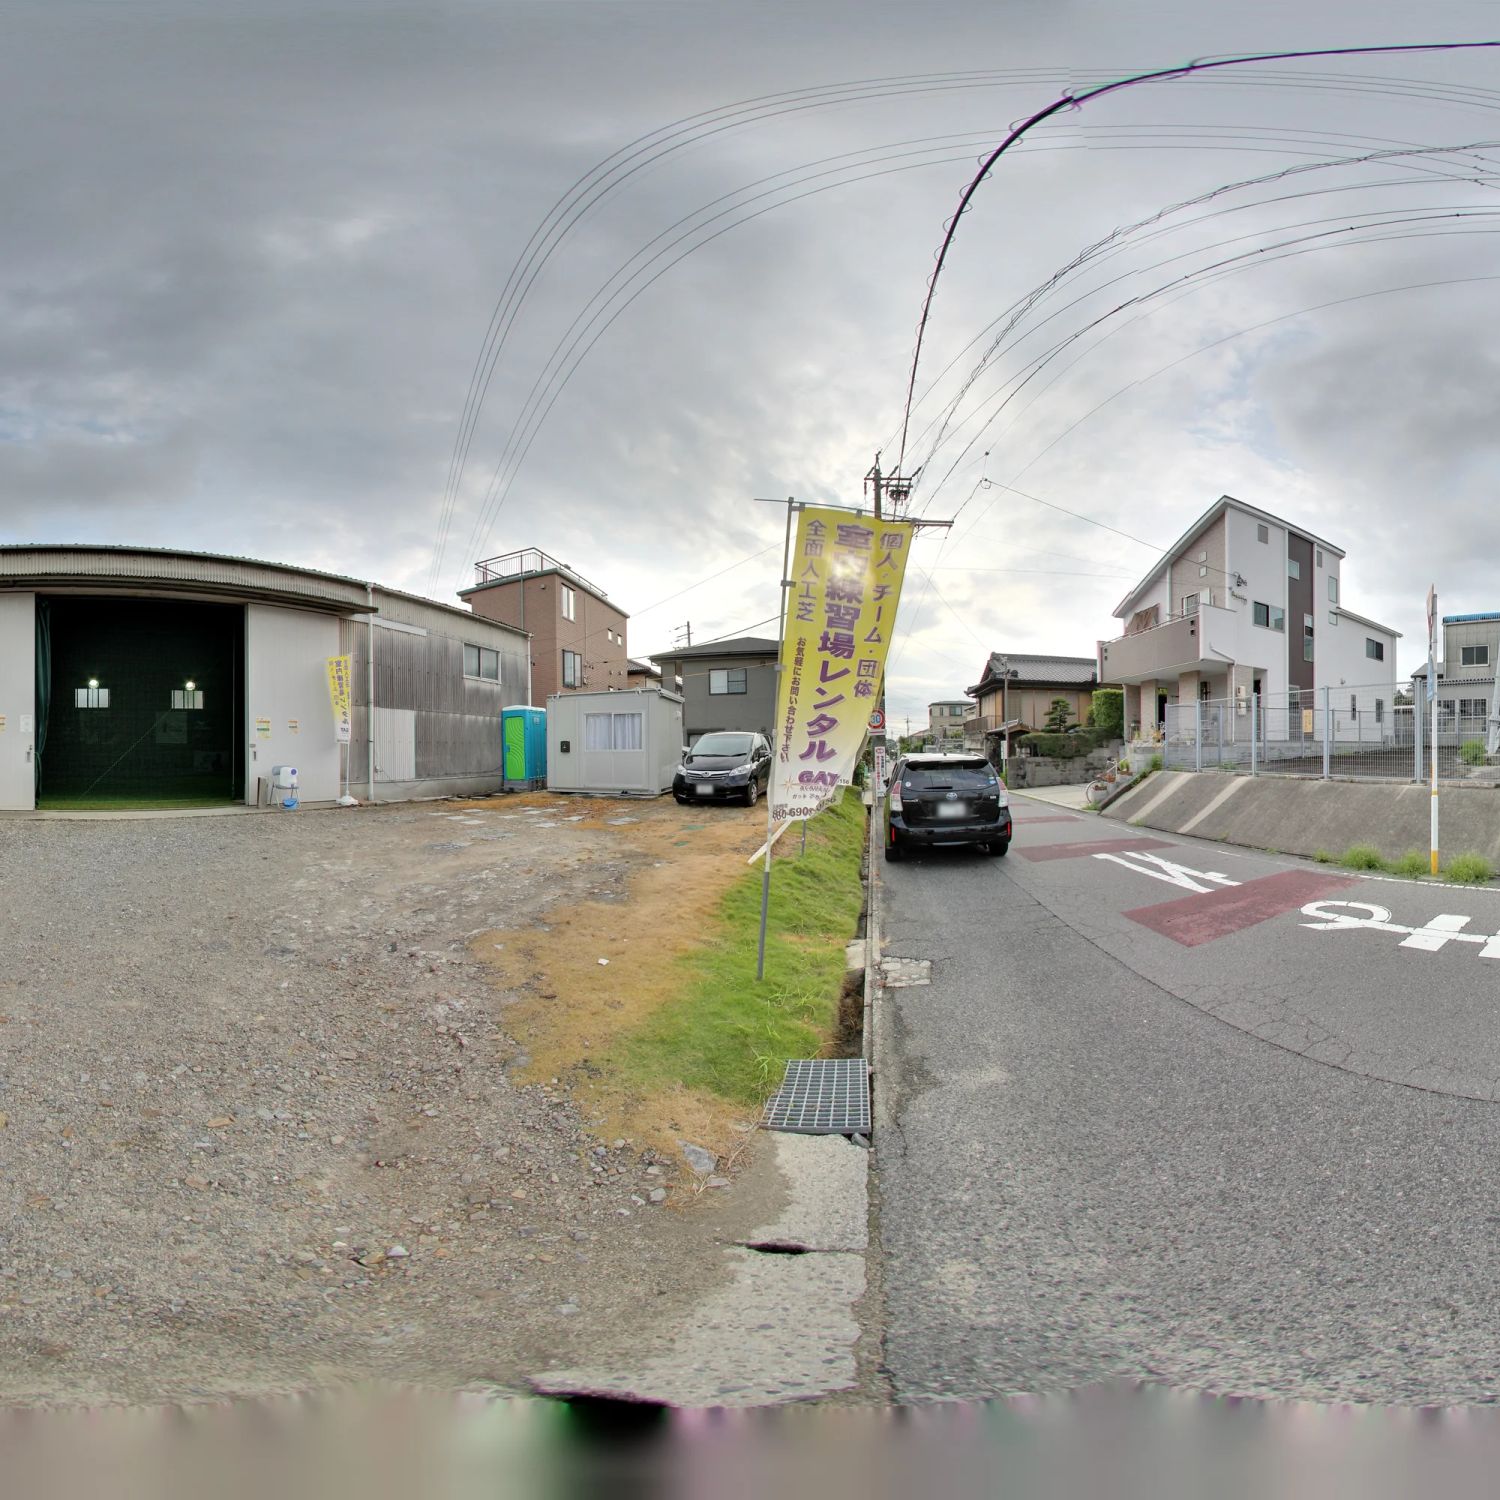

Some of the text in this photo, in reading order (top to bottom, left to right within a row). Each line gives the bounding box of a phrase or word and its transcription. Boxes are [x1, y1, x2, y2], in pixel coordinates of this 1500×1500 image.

[795, 519, 827, 623] 全面人工芝
[870, 714, 881, 724] 30
